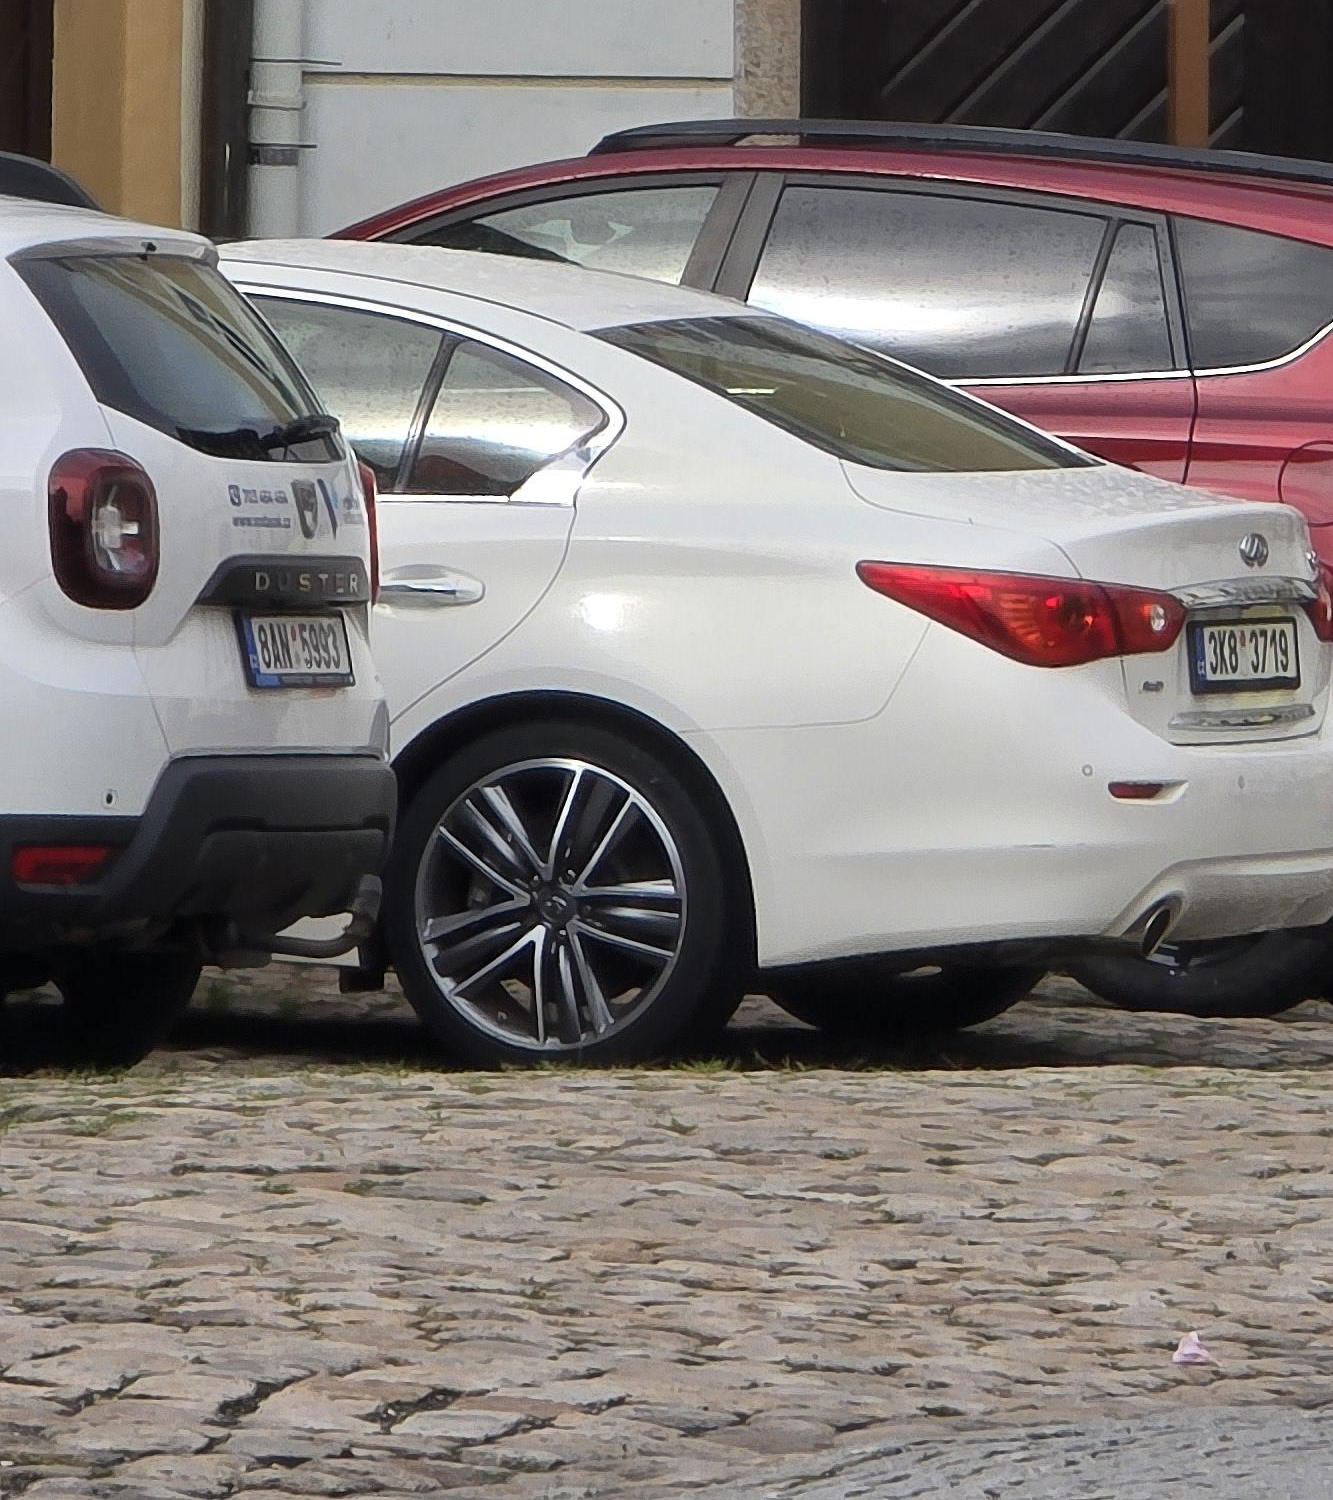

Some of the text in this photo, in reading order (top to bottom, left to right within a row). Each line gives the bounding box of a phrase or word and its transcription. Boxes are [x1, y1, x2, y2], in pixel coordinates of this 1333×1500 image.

[254, 571, 359, 595] DUSTER
[257, 621, 294, 670] 8AN
[1249, 627, 1290, 673] 3719
